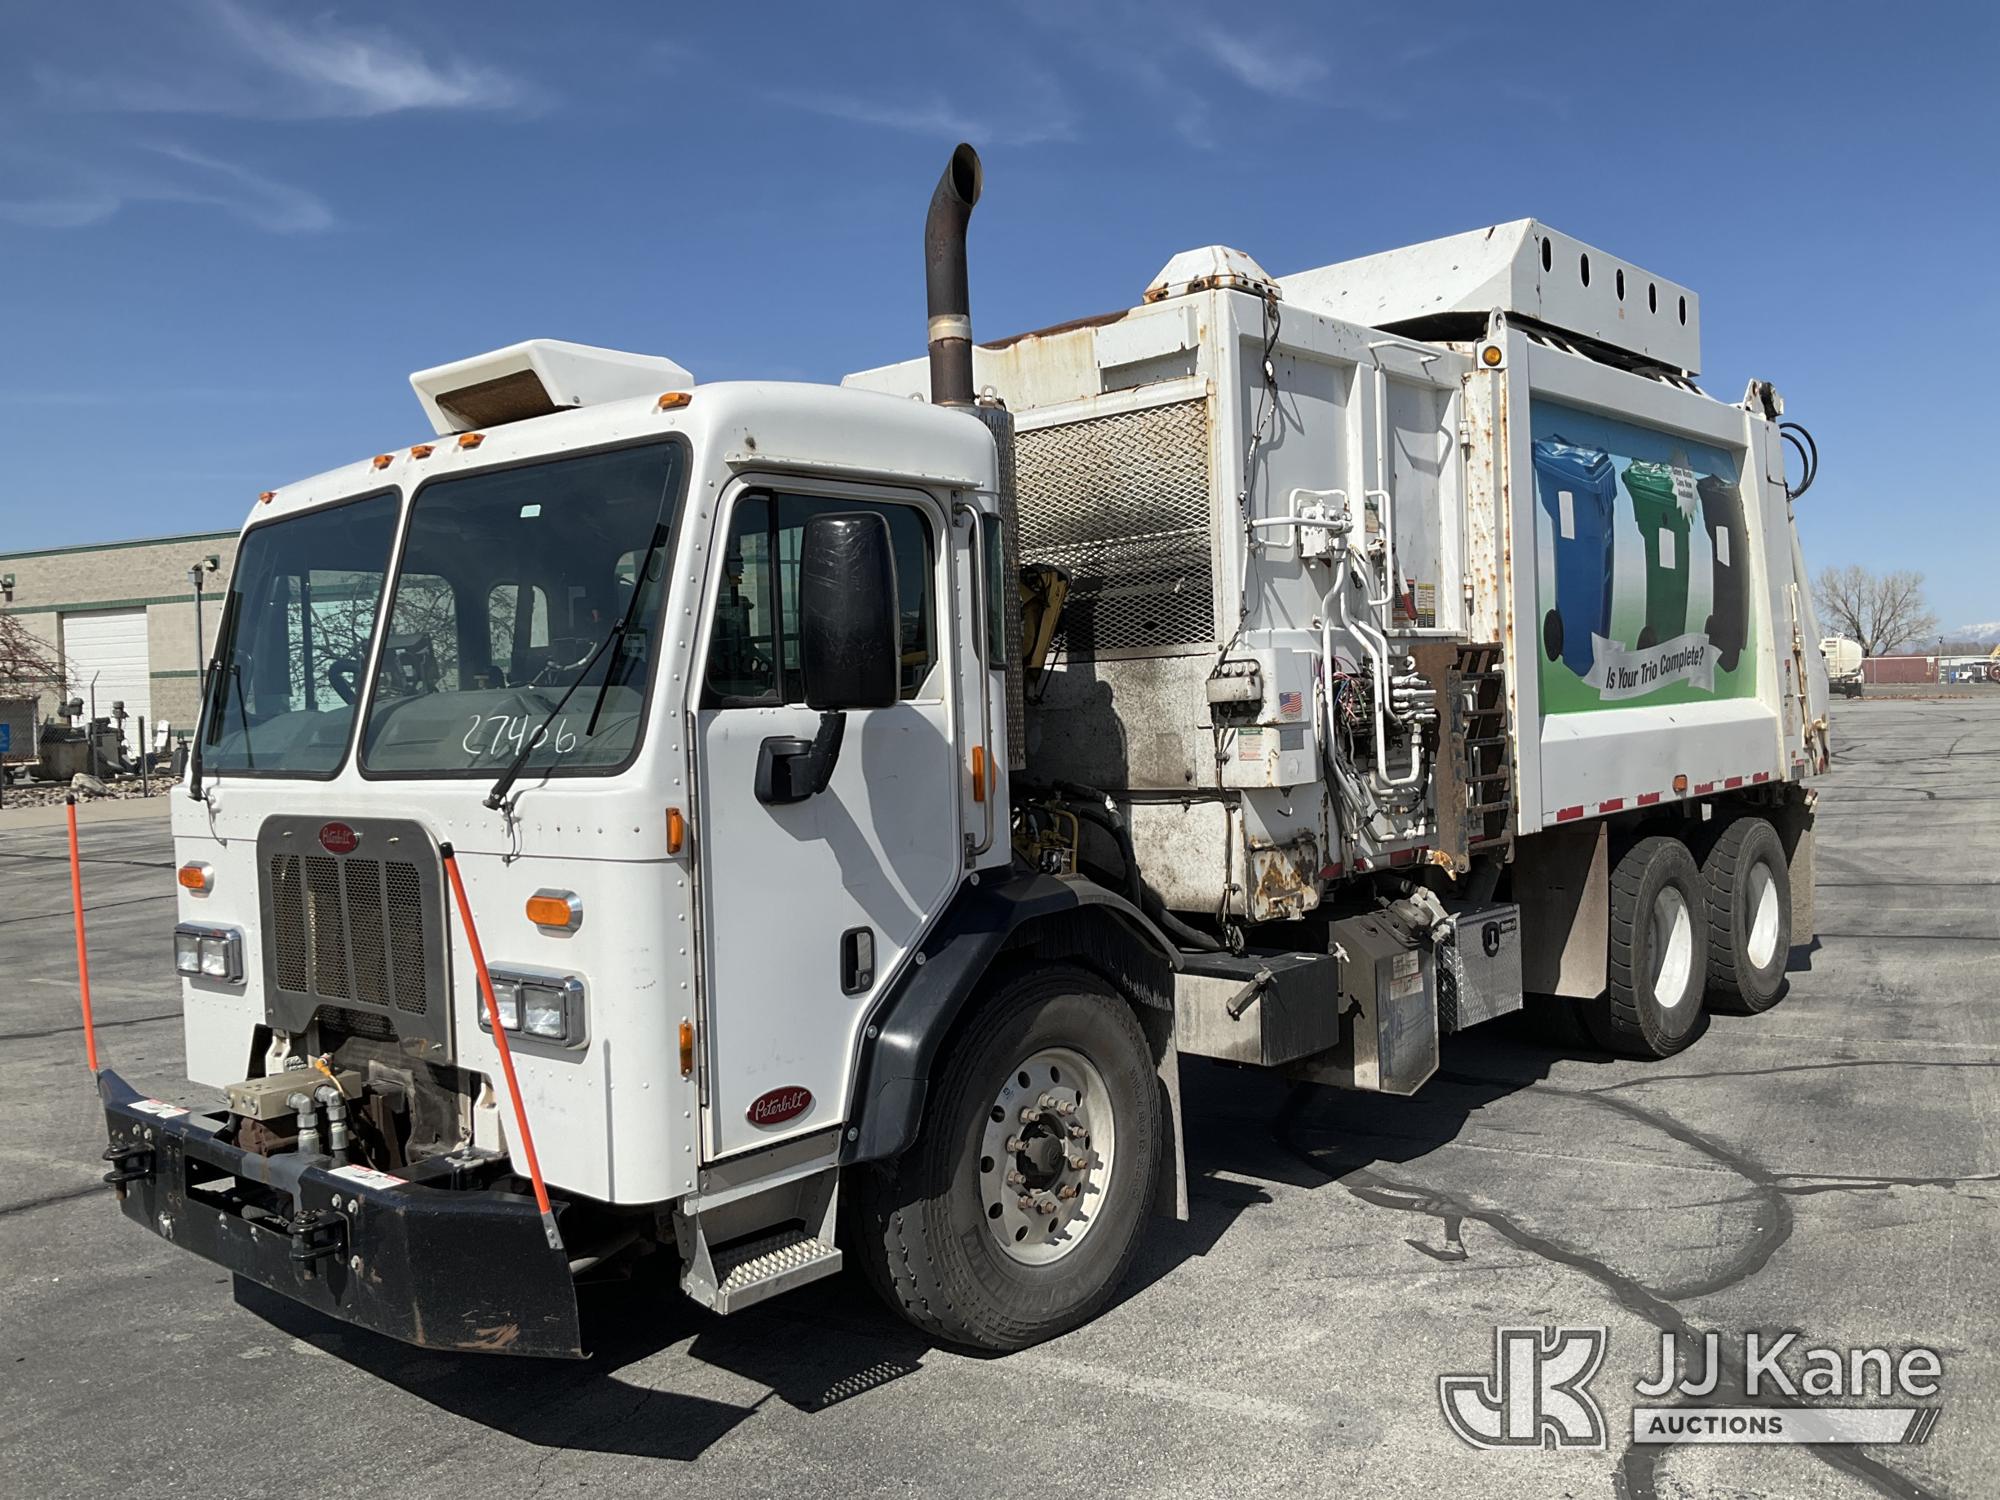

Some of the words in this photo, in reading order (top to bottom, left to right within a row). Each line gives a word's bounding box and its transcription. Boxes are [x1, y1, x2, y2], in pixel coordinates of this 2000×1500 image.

[1605, 666, 1616, 690] Is
[1618, 666, 1639, 689] Your
[1641, 660, 1658, 685] Trio
[1660, 645, 1705, 676] Complete?
[462, 714, 576, 757] 27406
[755, 1090, 808, 1121] Peterbilt
